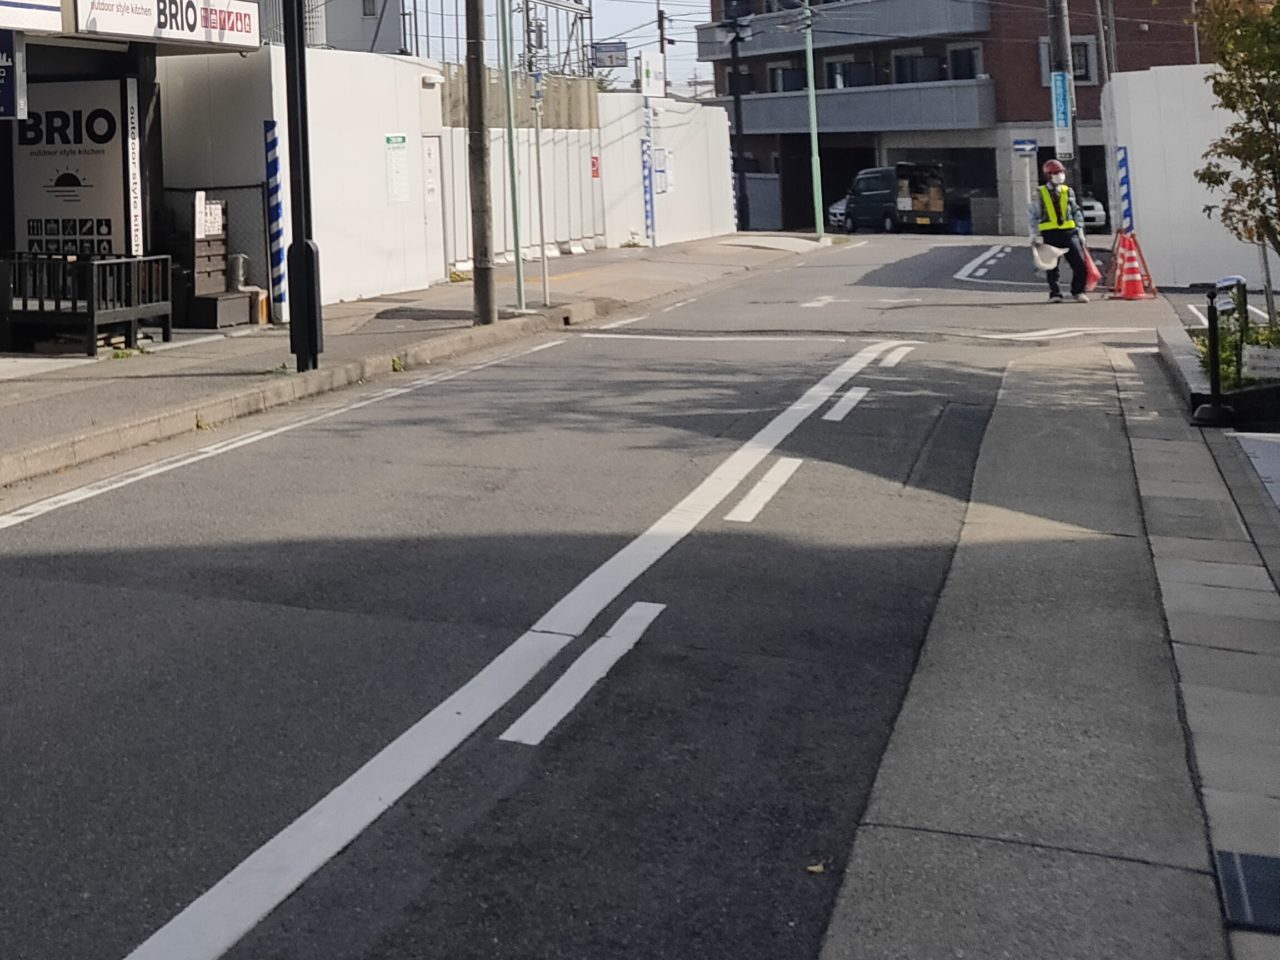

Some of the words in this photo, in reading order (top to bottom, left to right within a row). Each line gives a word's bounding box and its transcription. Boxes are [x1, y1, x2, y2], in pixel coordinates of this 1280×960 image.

[91, 0, 114, 12] outdoor
[116, 2, 130, 17] style
[131, 4, 152, 16] kitchen
[18, 108, 117, 146] BRIO
[129, 106, 138, 166] outdoor
[59, 148, 77, 158] style
[78, 147, 105, 156] kitchen
